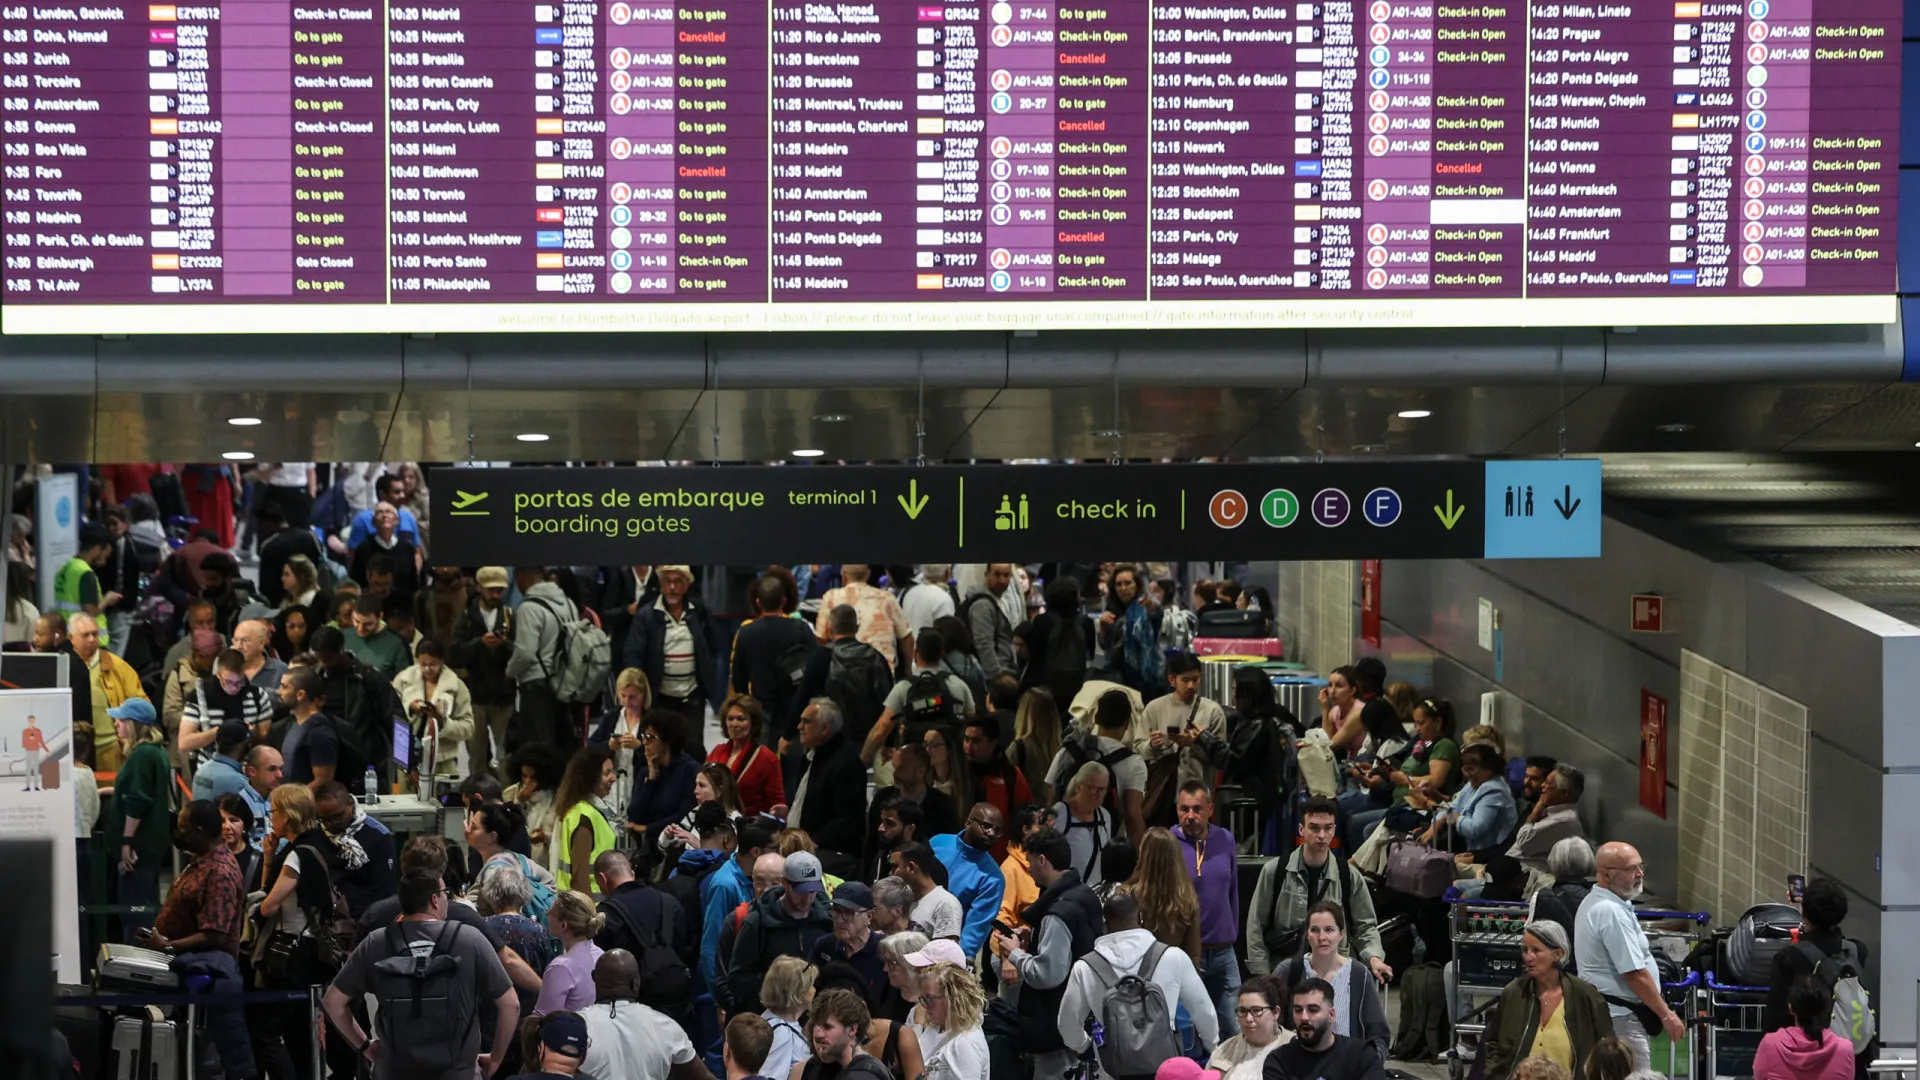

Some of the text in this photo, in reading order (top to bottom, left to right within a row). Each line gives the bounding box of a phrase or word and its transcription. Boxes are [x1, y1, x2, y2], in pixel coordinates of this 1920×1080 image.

[34, 7, 78, 20] London,
[80, 7, 124, 19] Gatwick
[294, 8, 337, 19] Check-in
[339, 8, 372, 19] Closed
[422, 8, 460, 20] Madrid
[633, 9, 673, 20] A01-A30
[679, 9, 692, 19] Go
[694, 10, 703, 19] to
[706, 10, 726, 22] gate
[805, 31, 822, 42] Rio
[825, 31, 838, 42] de
[840, 31, 880, 42] Janeiro
[1014, 31, 1053, 42] A01-A30
[1060, 31, 1101, 41] Check-in
[1104, 31, 1127, 43] Open
[1185, 30, 1220, 42] Berlin,
[1223, 30, 1292, 44] Brandenburg
[1392, 29, 1432, 40] A01-A30
[1438, 29, 1479, 39] Check-in
[1482, 29, 1505, 41] Open
[1563, 28, 1600, 42] Prague
[1770, 26, 1810, 37] A01-A30
[1816, 26, 1858, 36] Check-in
[1860, 26, 1884, 38] Open
[34, 52, 70, 65] Zurich
[295, 54, 308, 64] Go
[310, 55, 320, 64] to
[322, 55, 342, 67] gate
[34, 98, 99, 110] Amsterdam
[295, 99, 308, 109] Go
[310, 100, 320, 109] to
[322, 100, 343, 112] gate
[1561, 95, 1606, 107] Warsaw,
[1609, 94, 1646, 108] Chopin
[423, 121, 466, 134] London,
[468, 121, 499, 132] Luton
[679, 122, 692, 132] Go
[694, 123, 704, 132] to
[706, 123, 726, 134] gate
[805, 120, 855, 133] Brussels,
[858, 120, 908, 132] Charleroi
[1060, 120, 1105, 130] Cancelled
[1561, 117, 1599, 128] Munich
[423, 166, 478, 178] Eindhoven
[680, 166, 726, 176] Cancelled
[1183, 164, 1248, 178] Washington,
[1251, 163, 1285, 175] Dulles
[1436, 163, 1482, 173] Cancelled
[423, 188, 465, 200] Toronto
[633, 189, 673, 199] A01-A30
[679, 189, 692, 199] Go
[694, 190, 704, 198] to
[706, 190, 726, 201] gate
[1560, 184, 1616, 195] Marrakech
[1766, 183, 1806, 193] A01-A30
[1812, 183, 1854, 192] Check-in
[1856, 182, 1880, 194] Open
[1184, 208, 1233, 222] Budapest
[805, 232, 836, 244] Ponta
[838, 232, 882, 246] Delgada
[1059, 232, 1104, 242] Cancelled
[37, 257, 94, 271] Edinburgh
[296, 257, 319, 267] Gate
[320, 257, 353, 267] Closed
[424, 256, 453, 267] Porto
[456, 256, 486, 267] Santo
[641, 256, 666, 266] 14-18
[680, 256, 721, 266] Check-in
[724, 256, 748, 268] Open
[805, 255, 842, 266] Boston
[1013, 254, 1052, 264] A01-A30
[1059, 254, 1071, 264] Go
[1074, 256, 1082, 264] to
[1084, 256, 1104, 266] gate
[37, 279, 55, 291] Tel
[56, 280, 80, 291] Aviv
[297, 280, 310, 289] Go
[312, 280, 321, 289] to
[324, 281, 344, 292] gate
[1183, 275, 1202, 286] Sao
[1204, 275, 1236, 286] Paulo,
[1240, 275, 1291, 285] Guarulhos
[1389, 274, 1428, 284] A01-A30
[1435, 274, 1476, 284] Check-in
[1478, 274, 1502, 286] Open
[515, 488, 764, 513] portas de embarque
[788, 490, 876, 504] terminal 1
[1057, 499, 1155, 518] check in
[1220, 497, 1390, 520] C D E F
[515, 514, 690, 537] boarding gates
